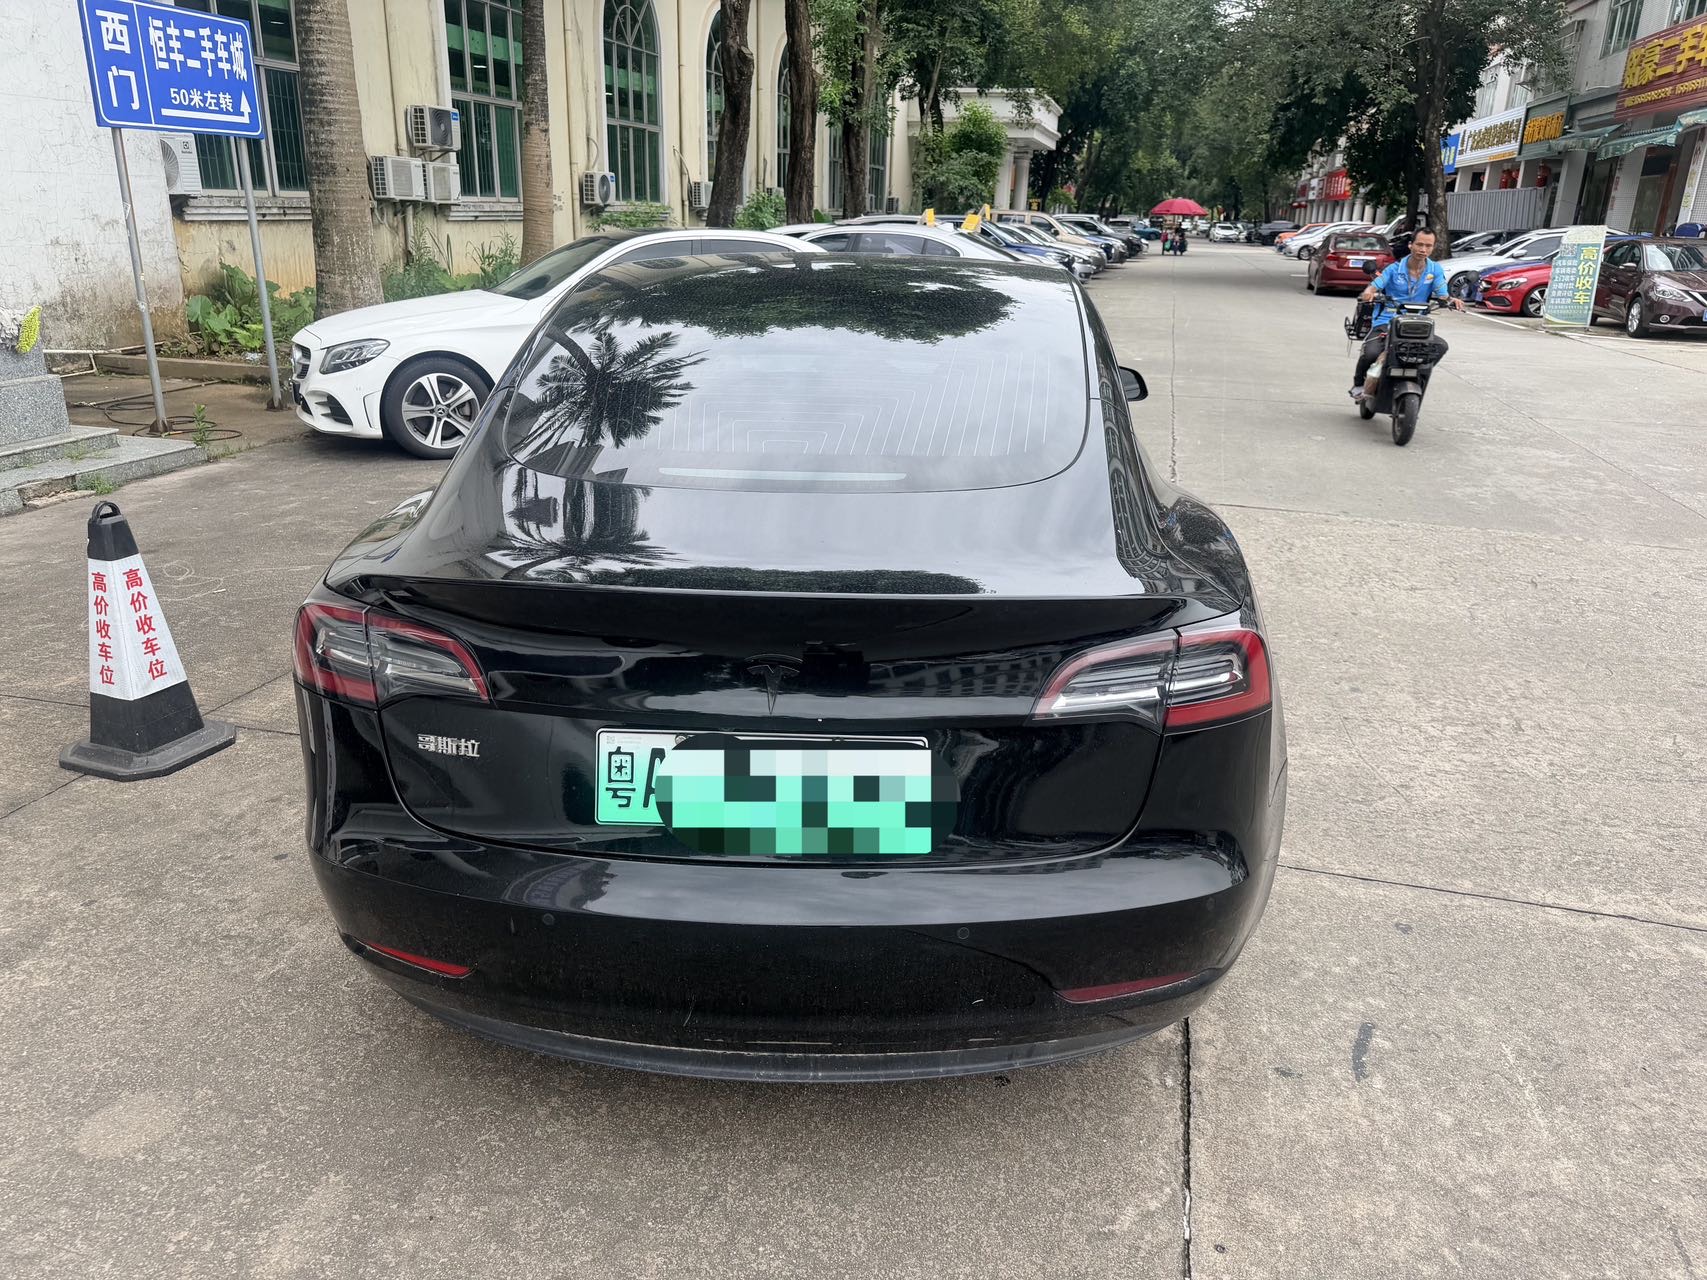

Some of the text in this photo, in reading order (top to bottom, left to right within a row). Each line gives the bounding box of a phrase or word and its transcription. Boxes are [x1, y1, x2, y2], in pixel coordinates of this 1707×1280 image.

[96, 9, 140, 110] 西门
[149, 16, 248, 82] 恒丰二手车城
[170, 88, 233, 112] 50米左转
[1573, 246, 1600, 305] 高价收车
[91, 571, 115, 685] 高价收车位
[122, 567, 168, 680] 高价收车位
[417, 733, 480, 757] 哥斯拉
